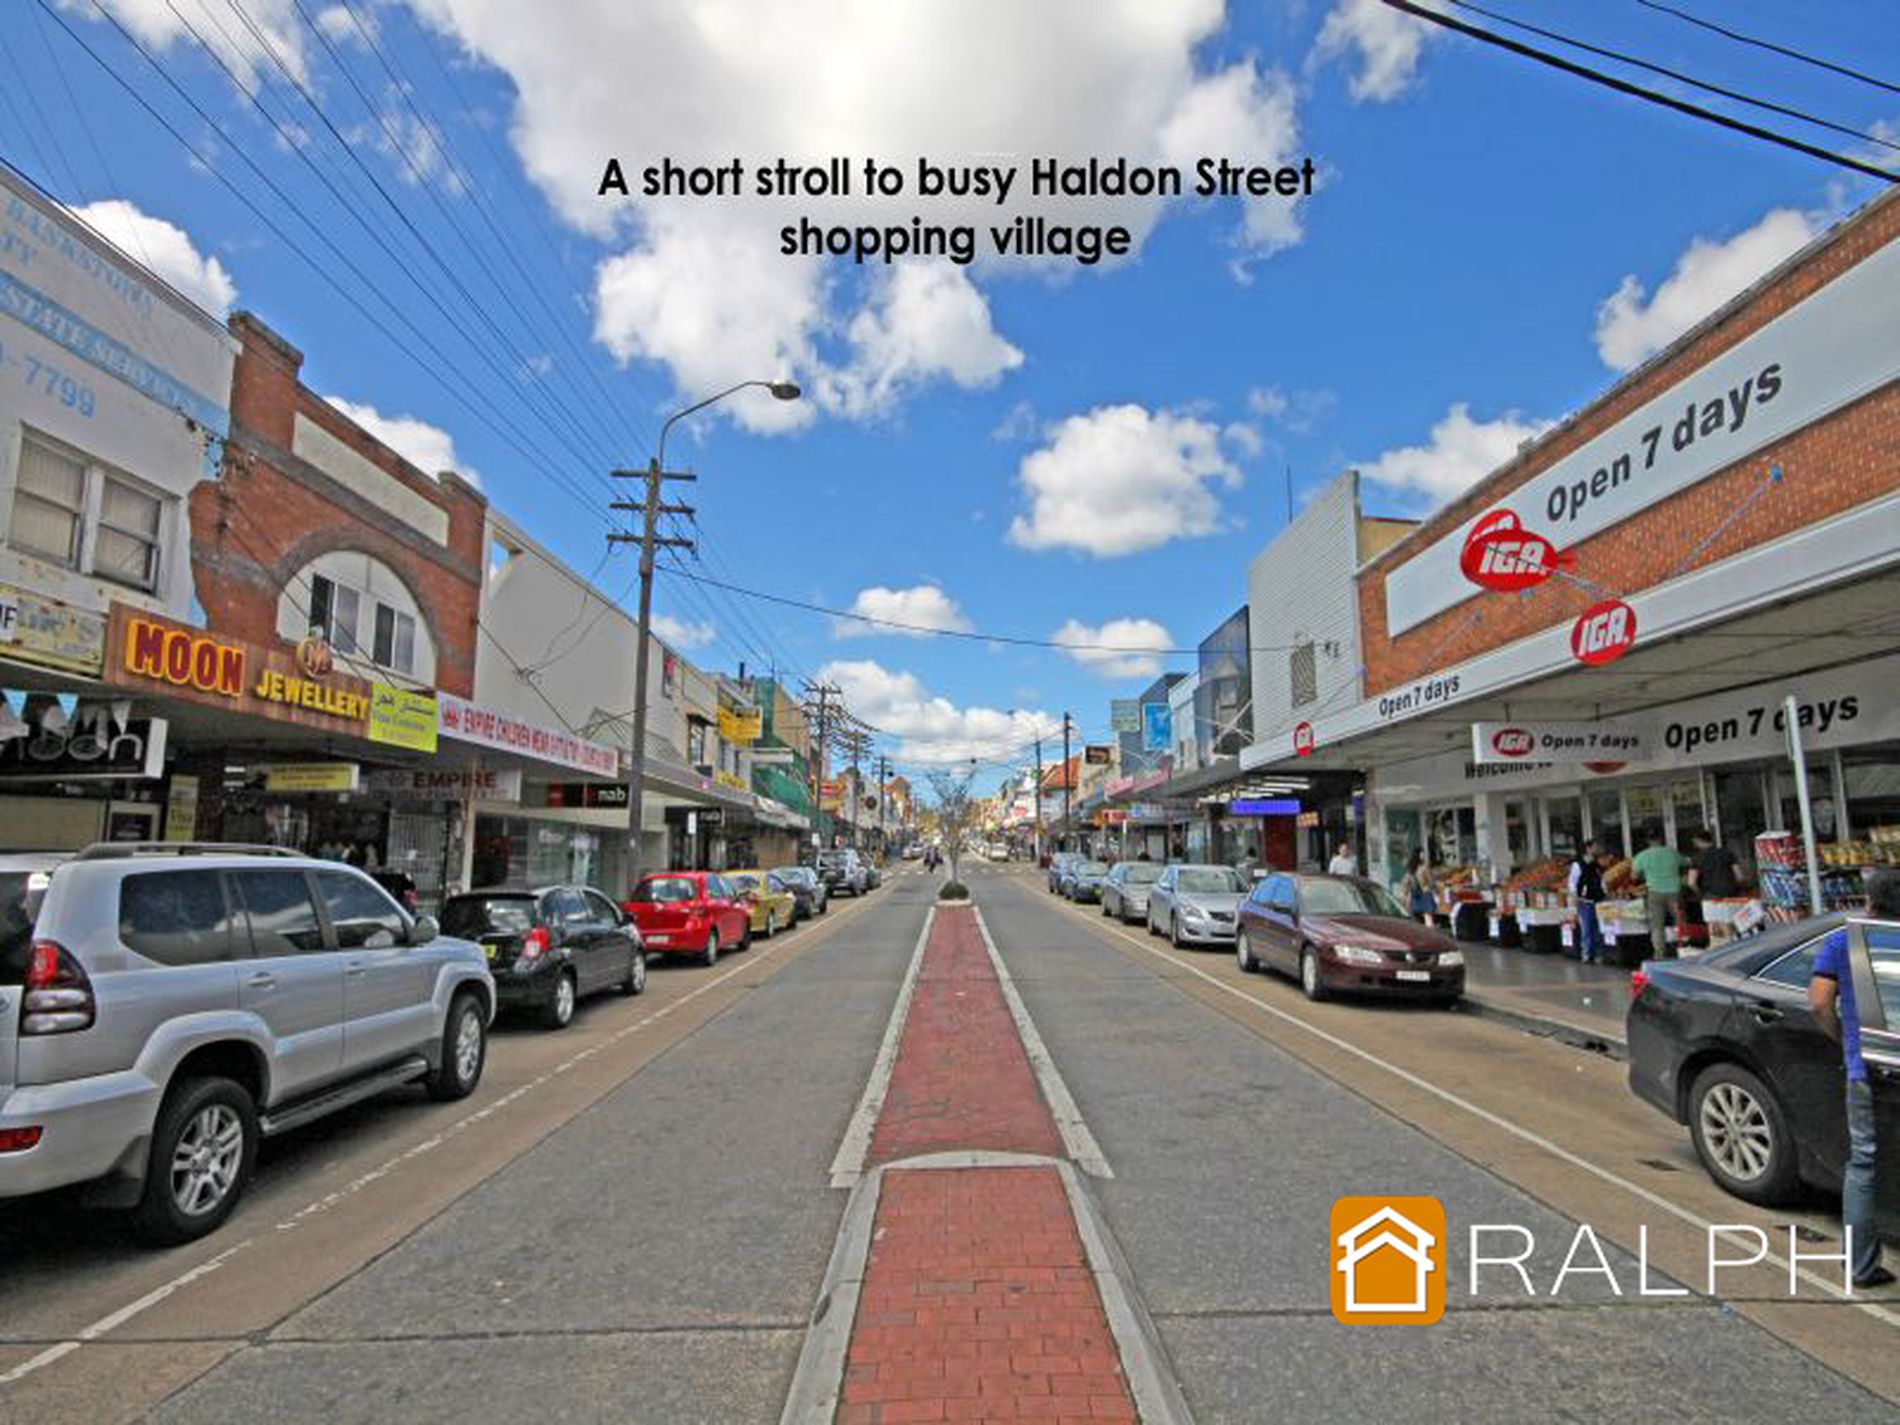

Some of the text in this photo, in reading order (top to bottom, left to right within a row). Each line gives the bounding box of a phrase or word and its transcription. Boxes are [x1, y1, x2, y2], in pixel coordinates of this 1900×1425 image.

[1547, 364, 1782, 521] Open 7 days
[1480, 541, 1545, 574] IGA
[1579, 607, 1628, 655] IGA
[127, 619, 245, 697] MOON
[256, 668, 369, 719] JEWELLERY
[1379, 676, 1460, 718] Open 7 days
[1541, 735, 1584, 750] Open
[1590, 735, 1598, 748] 7
[1601, 735, 1639, 749] days
[1665, 718, 1738, 752] Open
[1747, 708, 1764, 735] 7
[413, 770, 497, 790] EMPIRE
[598, 787, 627, 801] nab
